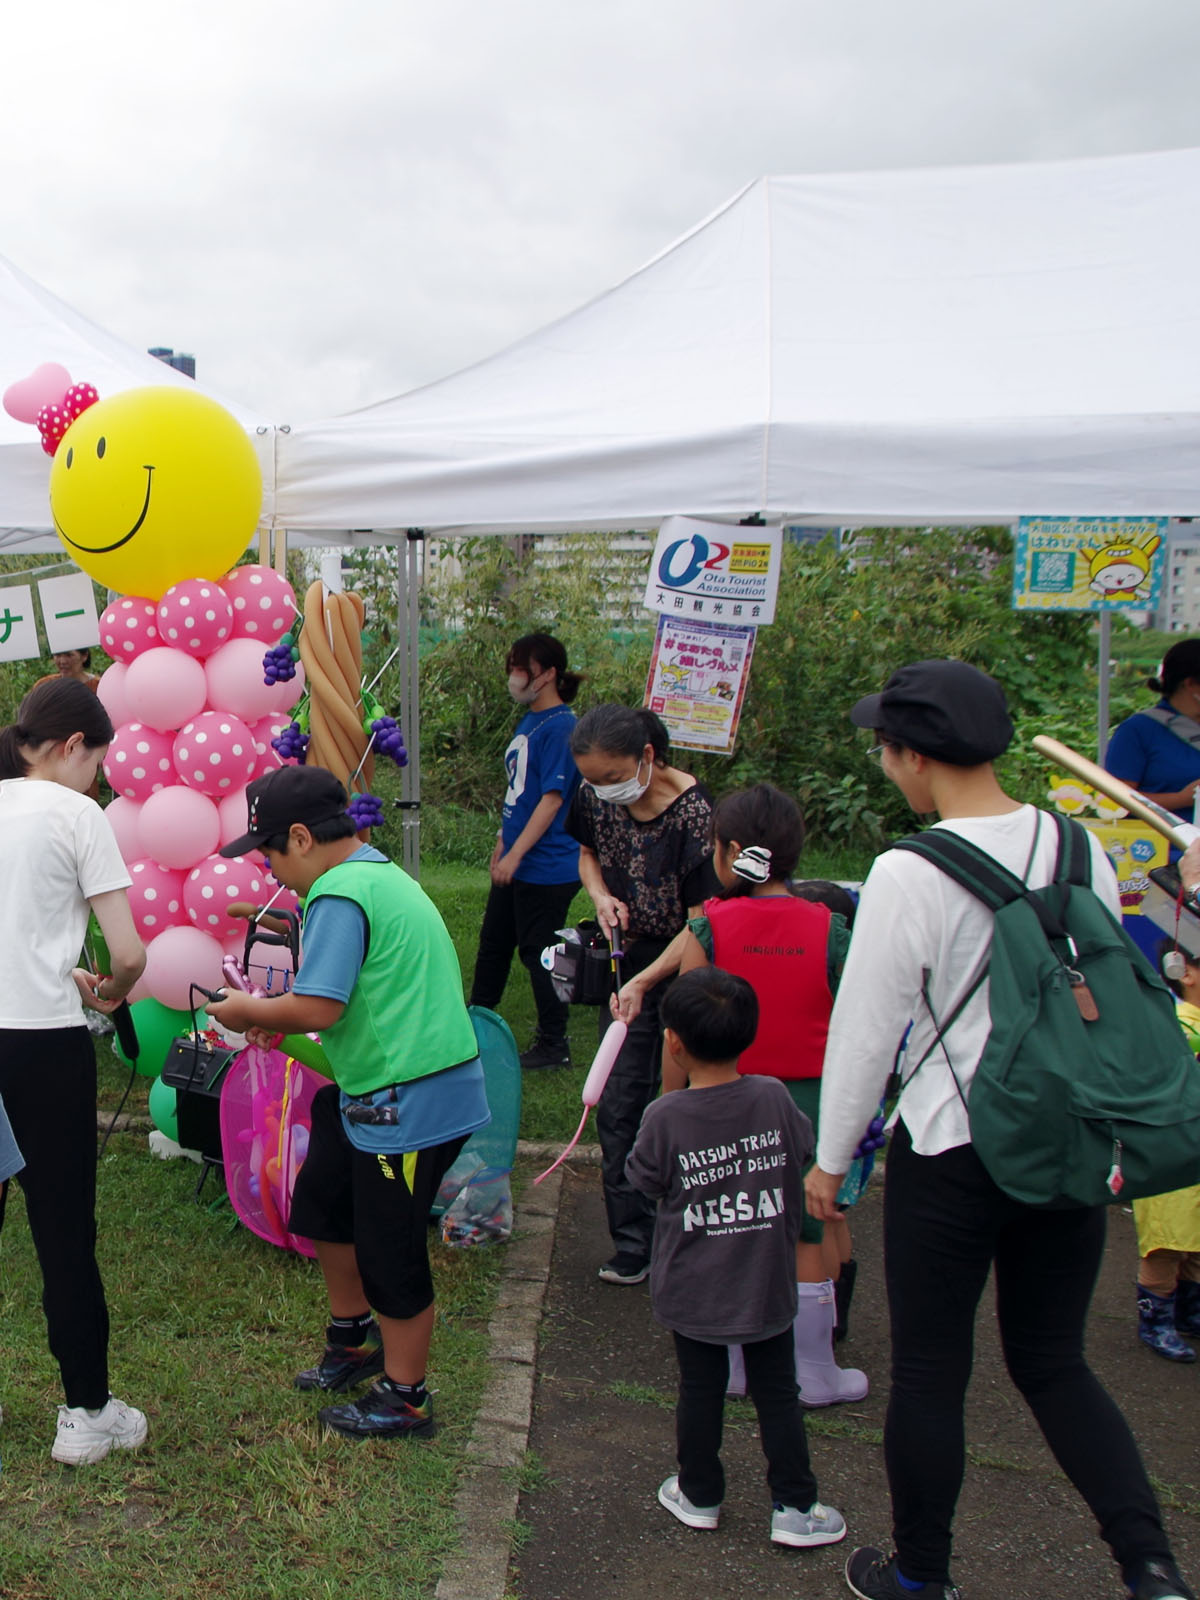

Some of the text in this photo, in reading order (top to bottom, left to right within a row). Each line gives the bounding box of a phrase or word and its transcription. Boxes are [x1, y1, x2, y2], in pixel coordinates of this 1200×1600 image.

[696, 582, 766, 596] Association
[703, 572, 767, 586] Ota Tourist
[656, 591, 761, 617] 大田観光協会
[678, 1143, 738, 1171] DATSUN
